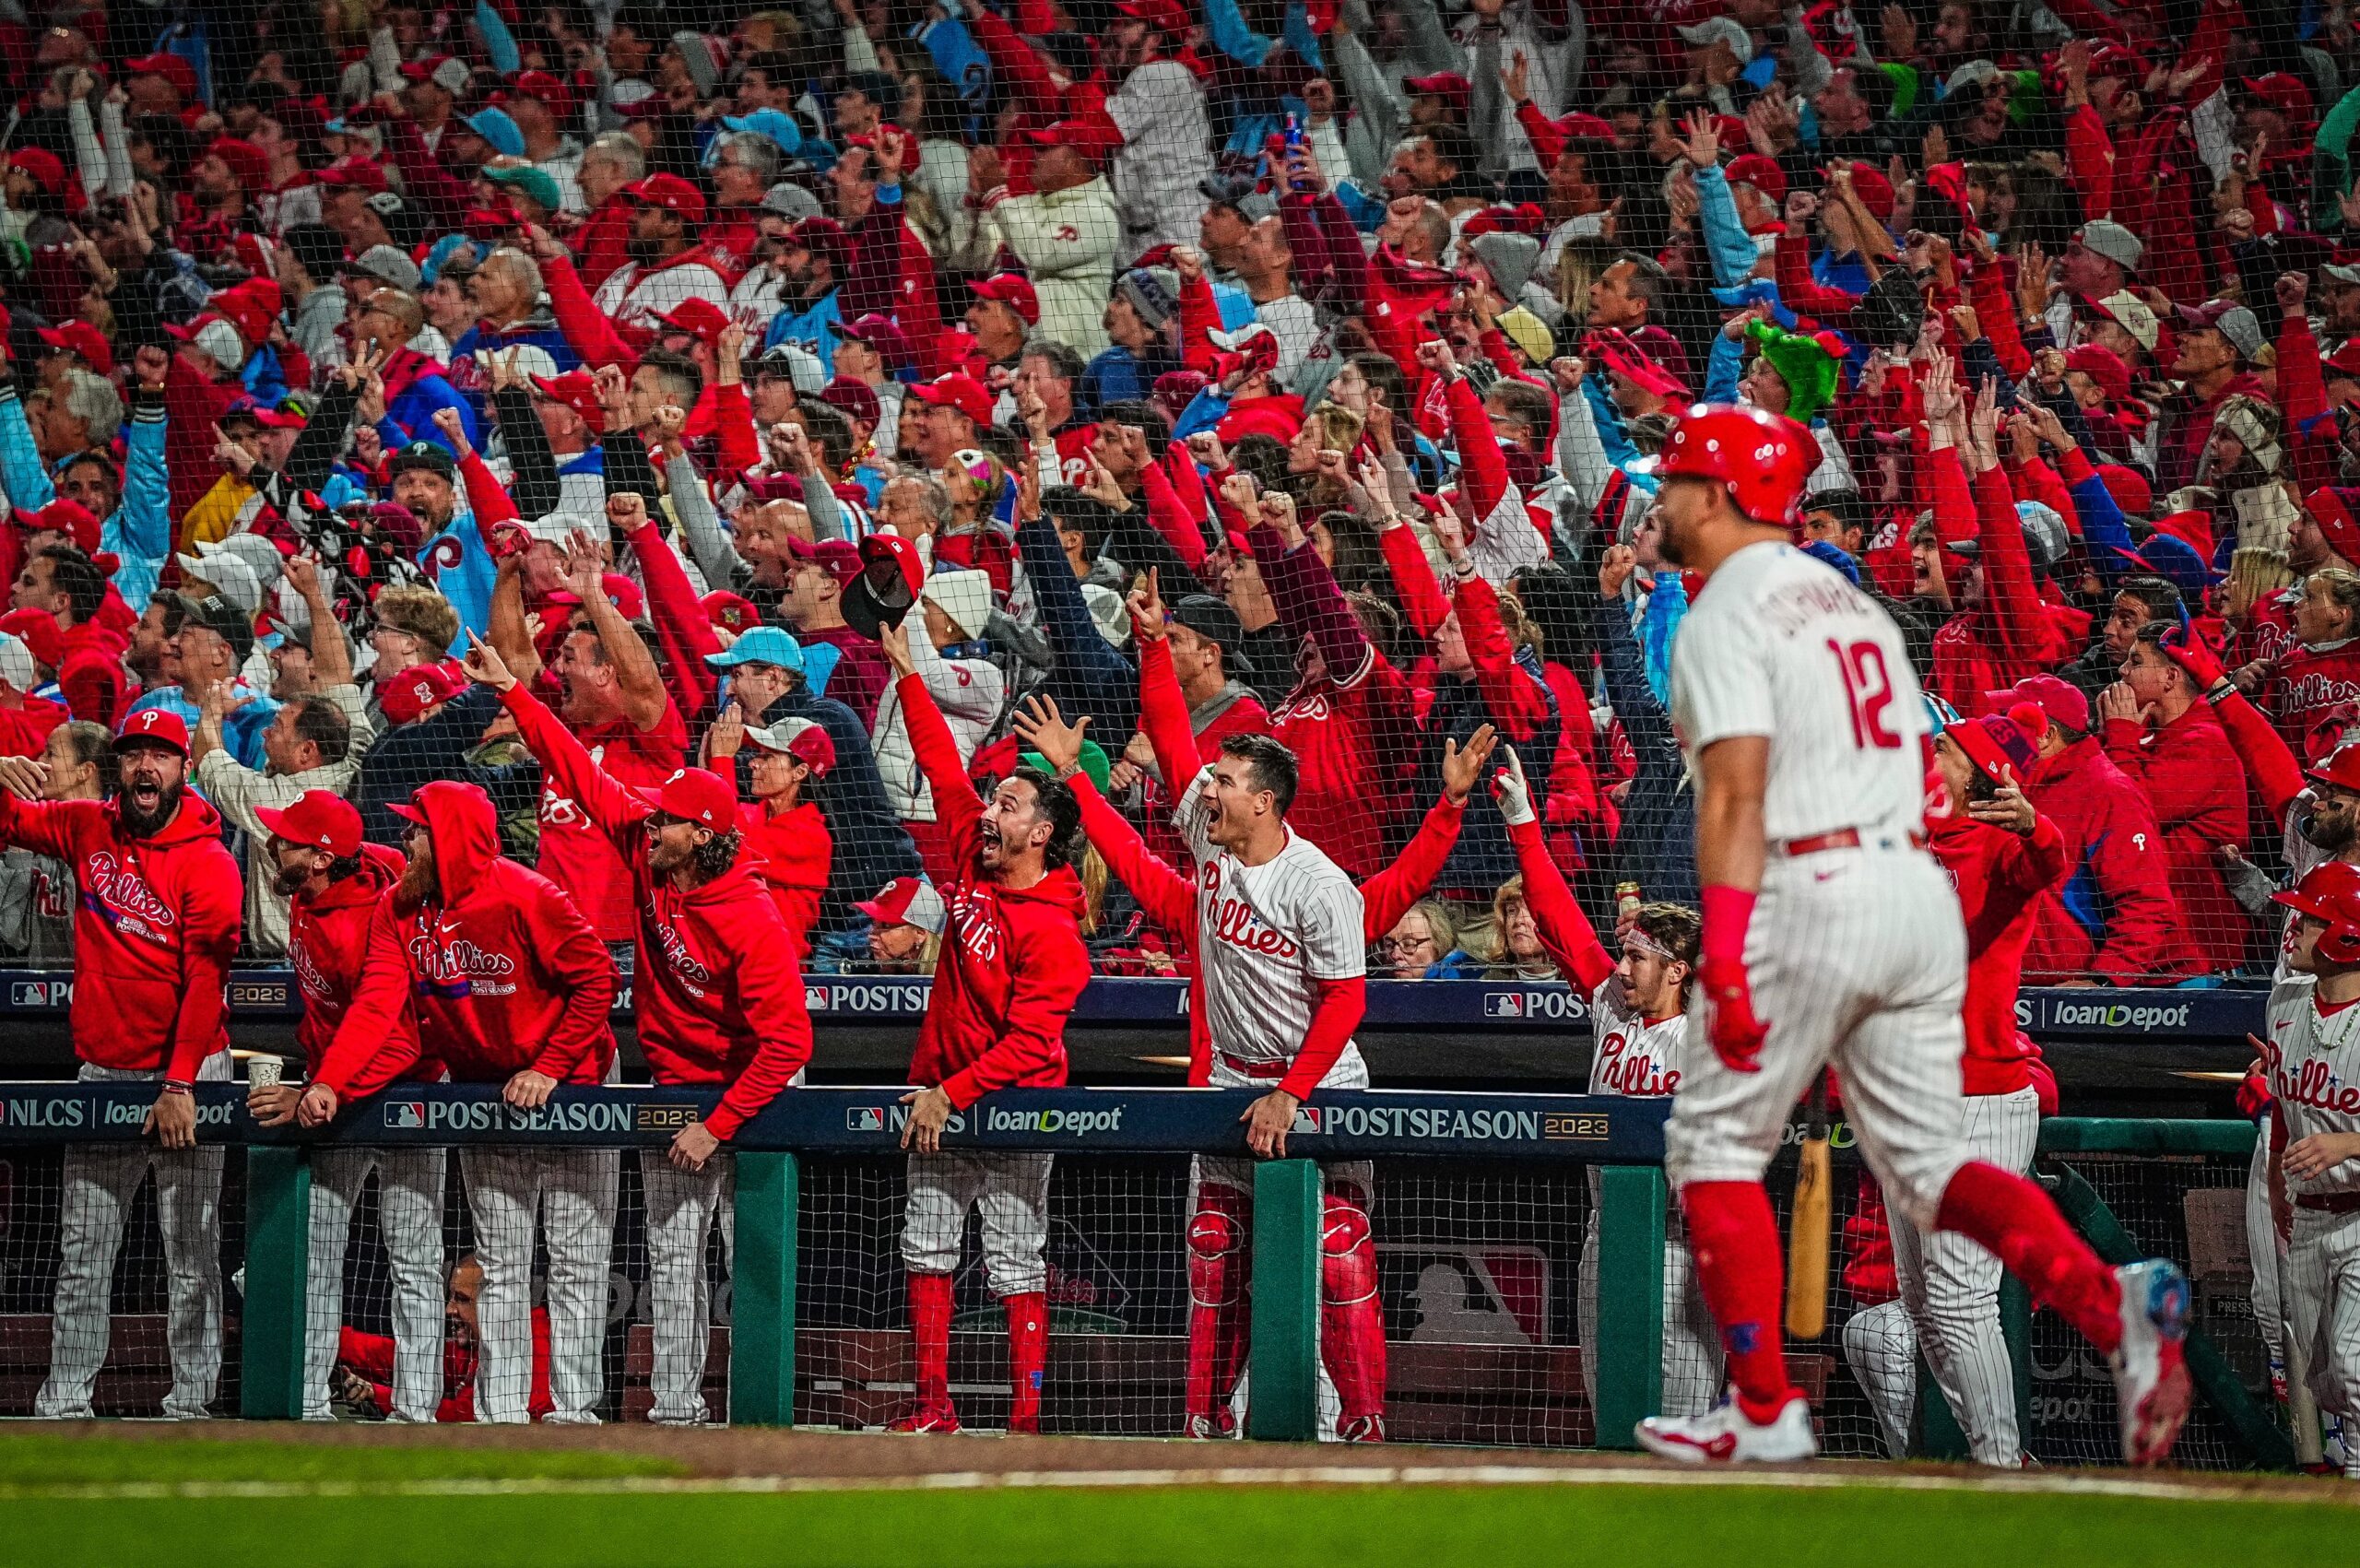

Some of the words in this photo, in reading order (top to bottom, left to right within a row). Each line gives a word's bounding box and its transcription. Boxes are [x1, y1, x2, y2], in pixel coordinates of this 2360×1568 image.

[1826, 639, 1902, 749] 12
[142, 711, 159, 730] P
[2132, 832, 2146, 852] P
[1203, 859, 1298, 959] Phllies
[408, 936, 515, 979] Phillies
[232, 987, 287, 1002] 2023
[2054, 1000, 2190, 1032] loanDepot
[9, 1099, 85, 1126] NLCS
[428, 1102, 631, 1132] POSTSEASON
[637, 1110, 698, 1126] 2023
[986, 1106, 1122, 1137] loanDepot
[1324, 1106, 1539, 1140] POSTSEASON
[1544, 1118, 1609, 1135] 2023
